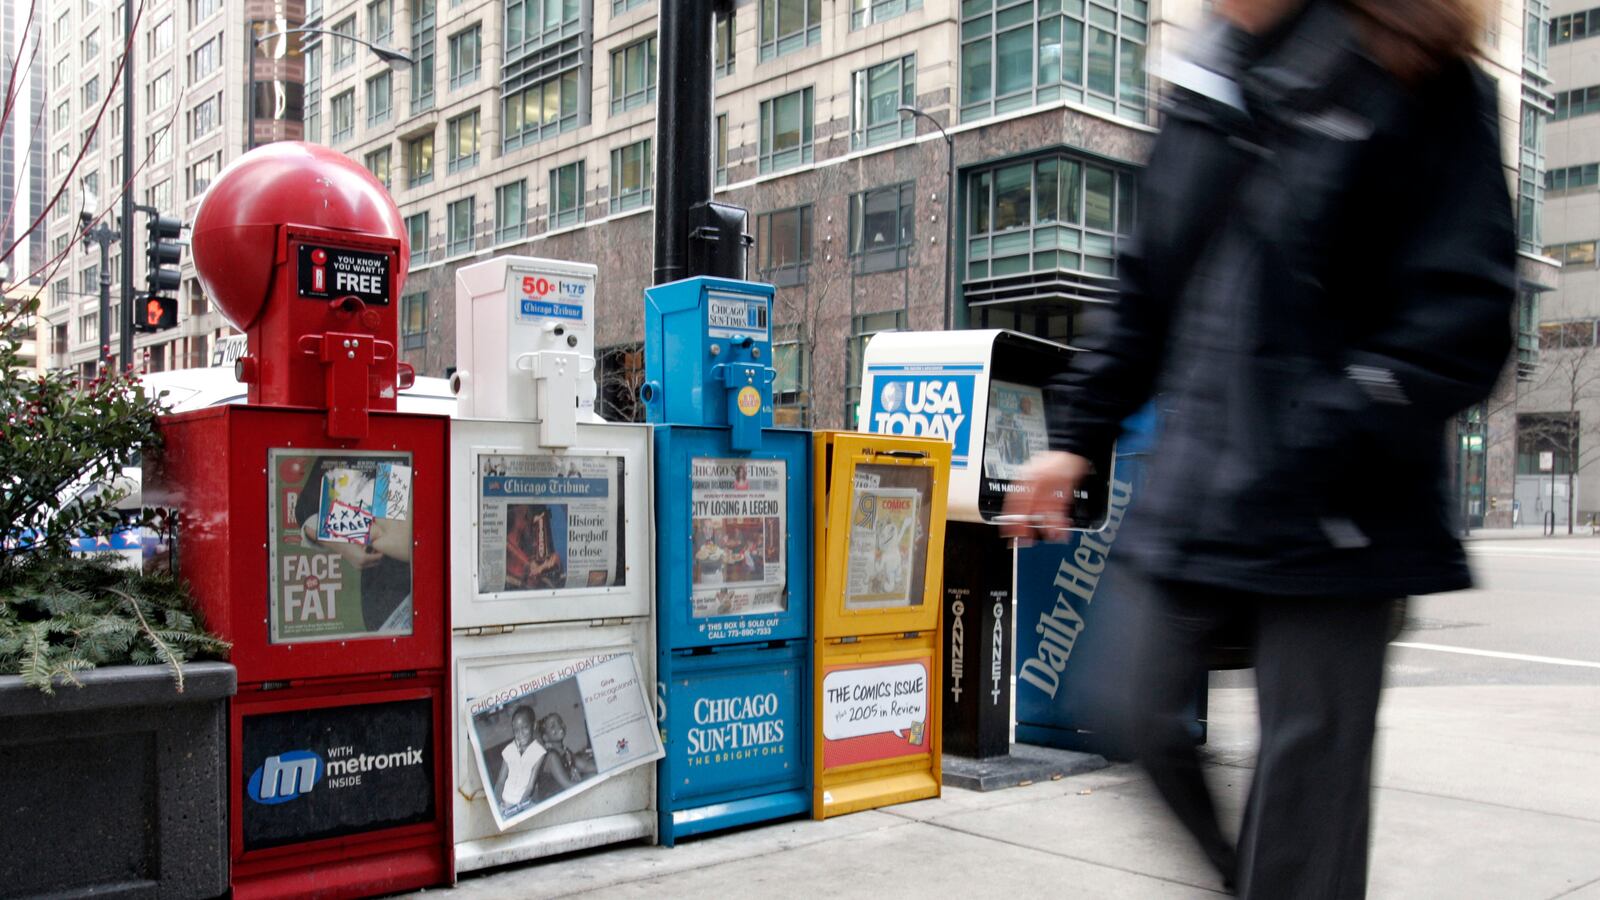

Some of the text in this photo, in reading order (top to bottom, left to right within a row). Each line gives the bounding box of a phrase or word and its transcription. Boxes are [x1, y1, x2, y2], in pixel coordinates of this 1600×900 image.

[334, 262, 351, 271] YOU
[353, 265, 376, 273] WANT
[338, 255, 382, 268] YOU KNOW
[336, 272, 382, 294] FREE
[523, 303, 580, 317] Chicago Tribune
[711, 303, 745, 316] CHICAGO
[709, 314, 747, 328] SUN-TIMES
[904, 380, 963, 414] USA
[874, 412, 966, 451] TODAY
[692, 463, 728, 477] HICAGO
[503, 478, 591, 495] Chicago Tribune
[988, 482, 1001, 492] THE
[711, 500, 740, 516] LOSING
[742, 500, 748, 514] A
[749, 500, 779, 515] LEGEND
[881, 499, 910, 511] COMICS
[569, 514, 605, 527] Historic
[568, 530, 608, 544] Berghoff
[568, 545, 602, 558] to close
[283, 553, 342, 582] FACE
[284, 582, 343, 623] FAT
[699, 618, 779, 632] IF THIS BOX IS SOLD OUT
[708, 629, 726, 639] CALL:
[951, 600, 965, 703] GANNETT
[991, 602, 1004, 705] GANNETT
[1018, 592, 1085, 700] Daily
[470, 687, 520, 715] CHICAGO
[520, 671, 557, 695] TRIBUNE
[557, 655, 596, 680] HOLIDAY
[827, 677, 924, 704] THE COMICS ISSUE
[693, 693, 779, 725] CHICAGO
[849, 703, 878, 722] 2005
[879, 707, 888, 718] in
[890, 700, 921, 716] Review
[687, 719, 785, 755] SUN-TIMES
[327, 746, 353, 758] WITH
[687, 745, 785, 767] THE BRIGHT ONE
[326, 746, 423, 777] metromix
[328, 774, 362, 789] INSIDE
